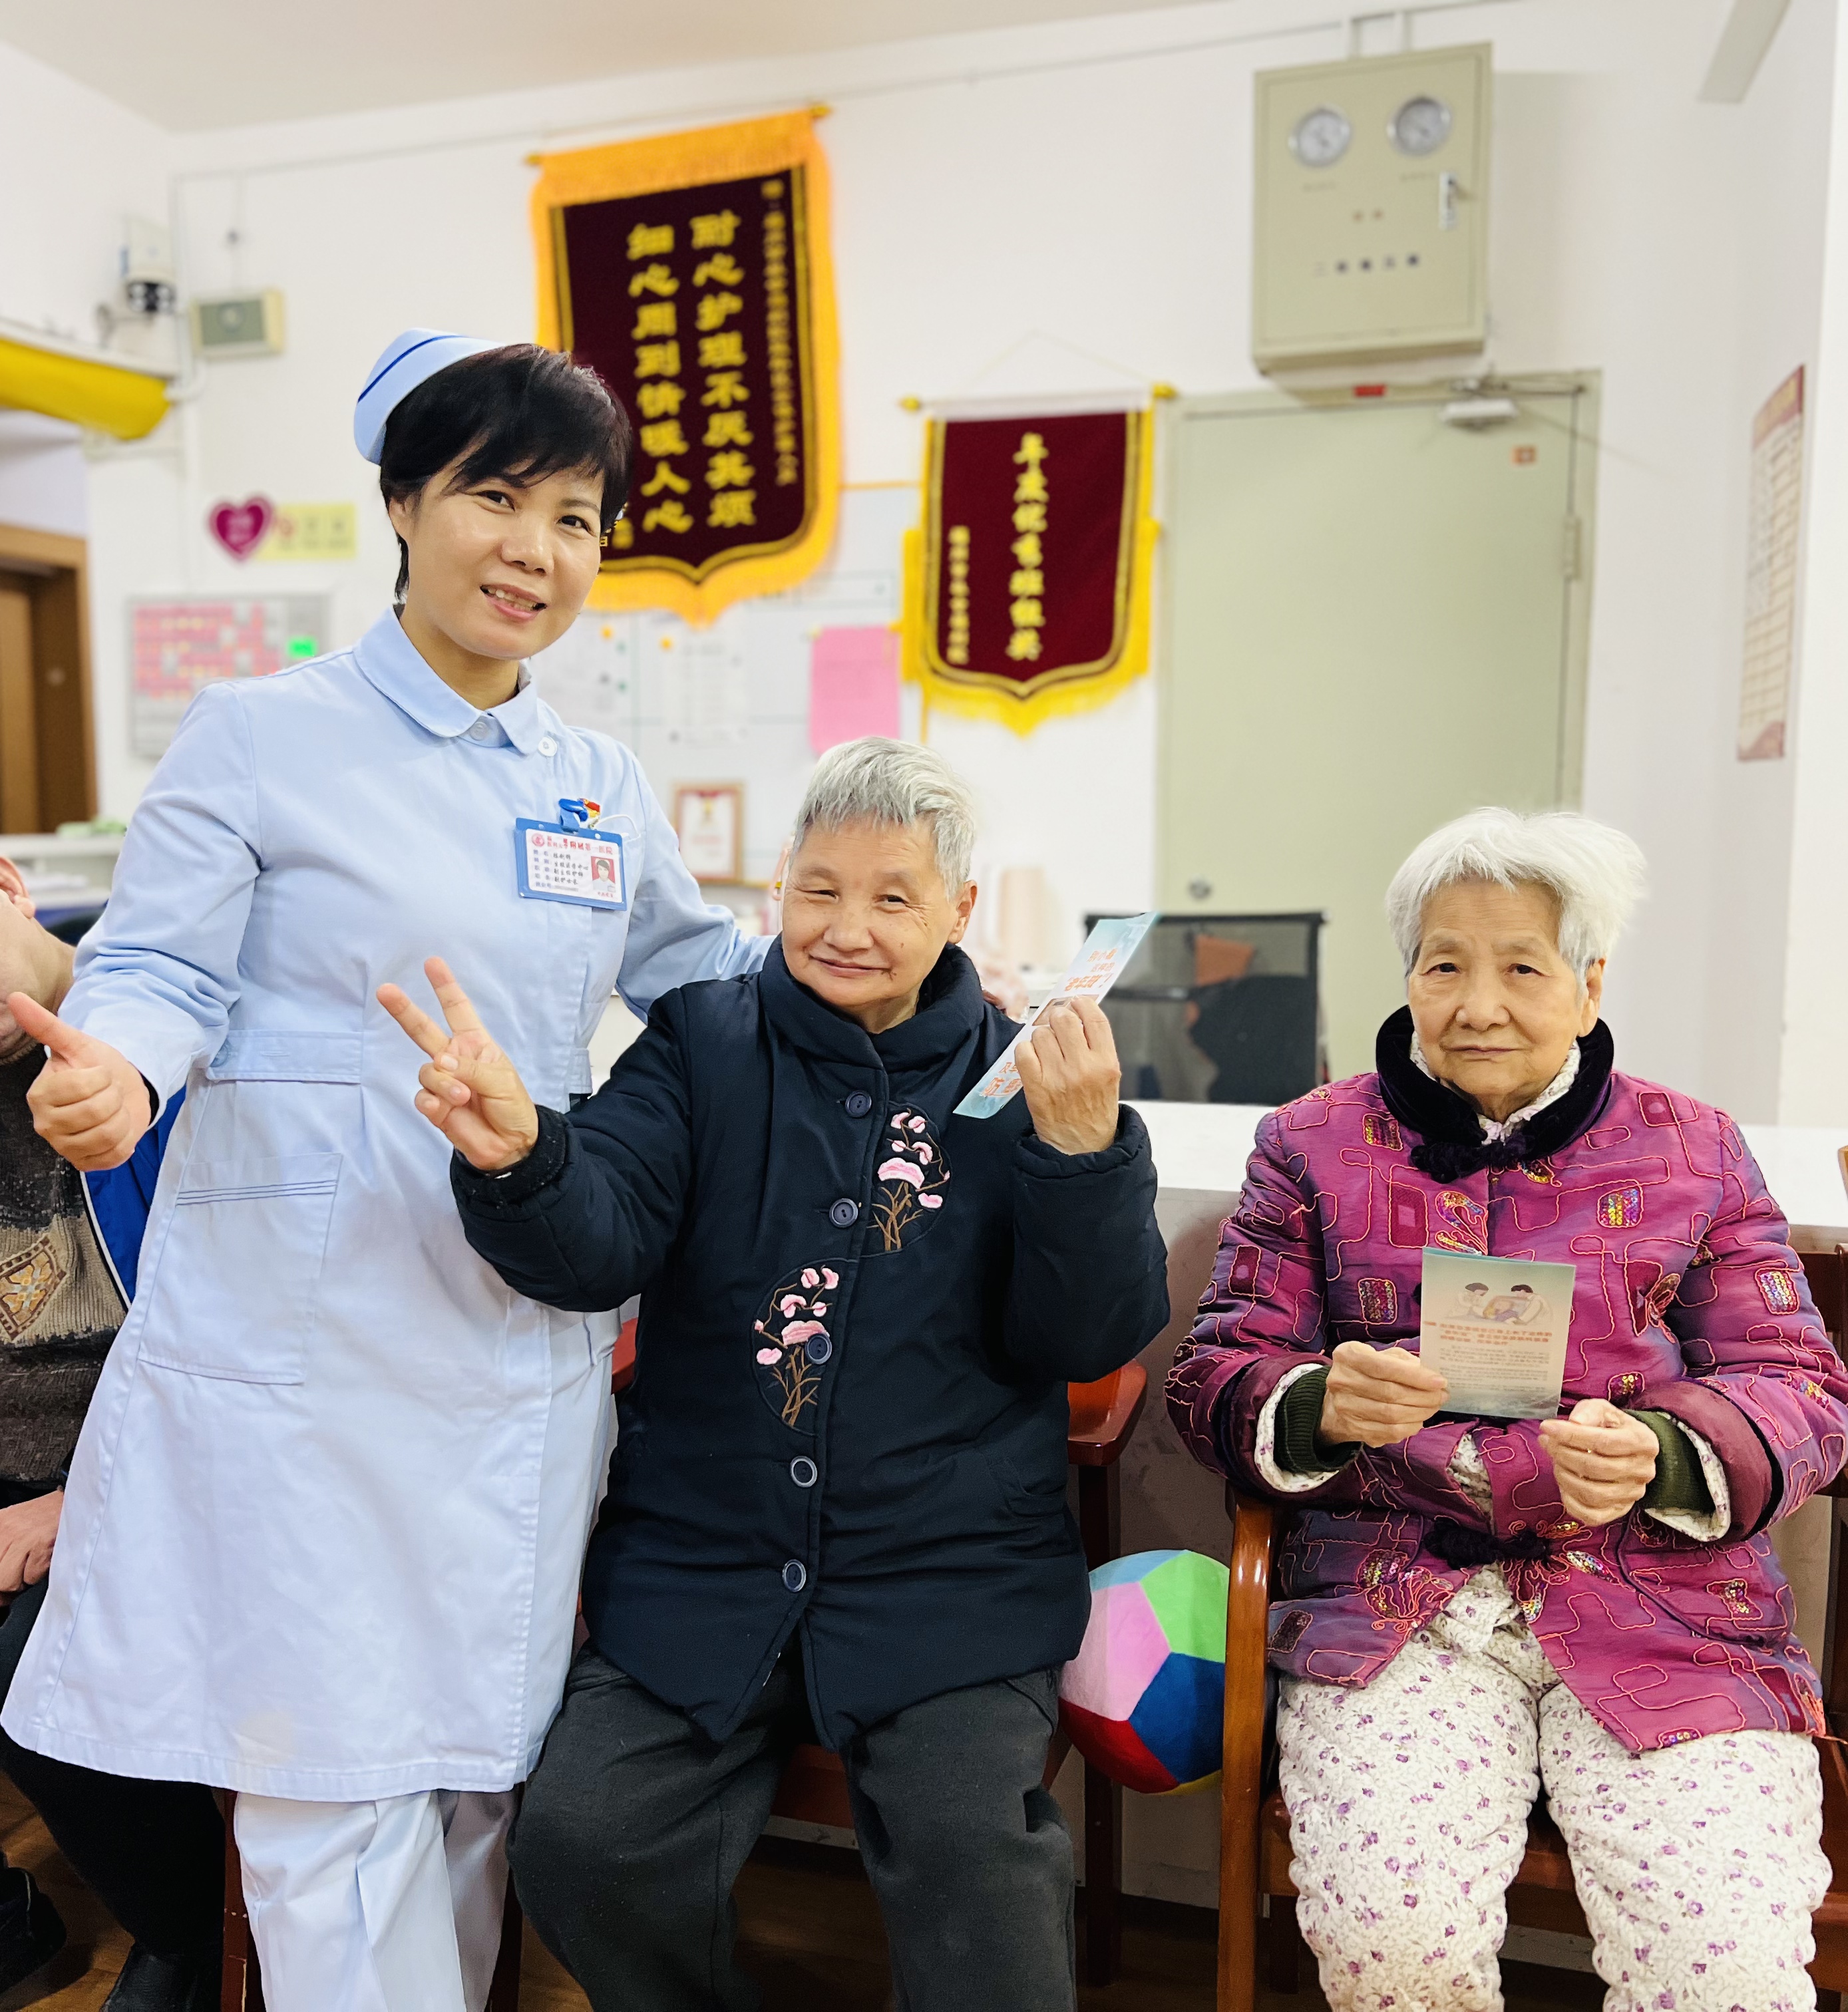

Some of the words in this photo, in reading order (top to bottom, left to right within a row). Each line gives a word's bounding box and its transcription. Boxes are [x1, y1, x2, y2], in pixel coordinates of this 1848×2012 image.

[689, 209, 757, 528] 耐心护理不厌其烦
